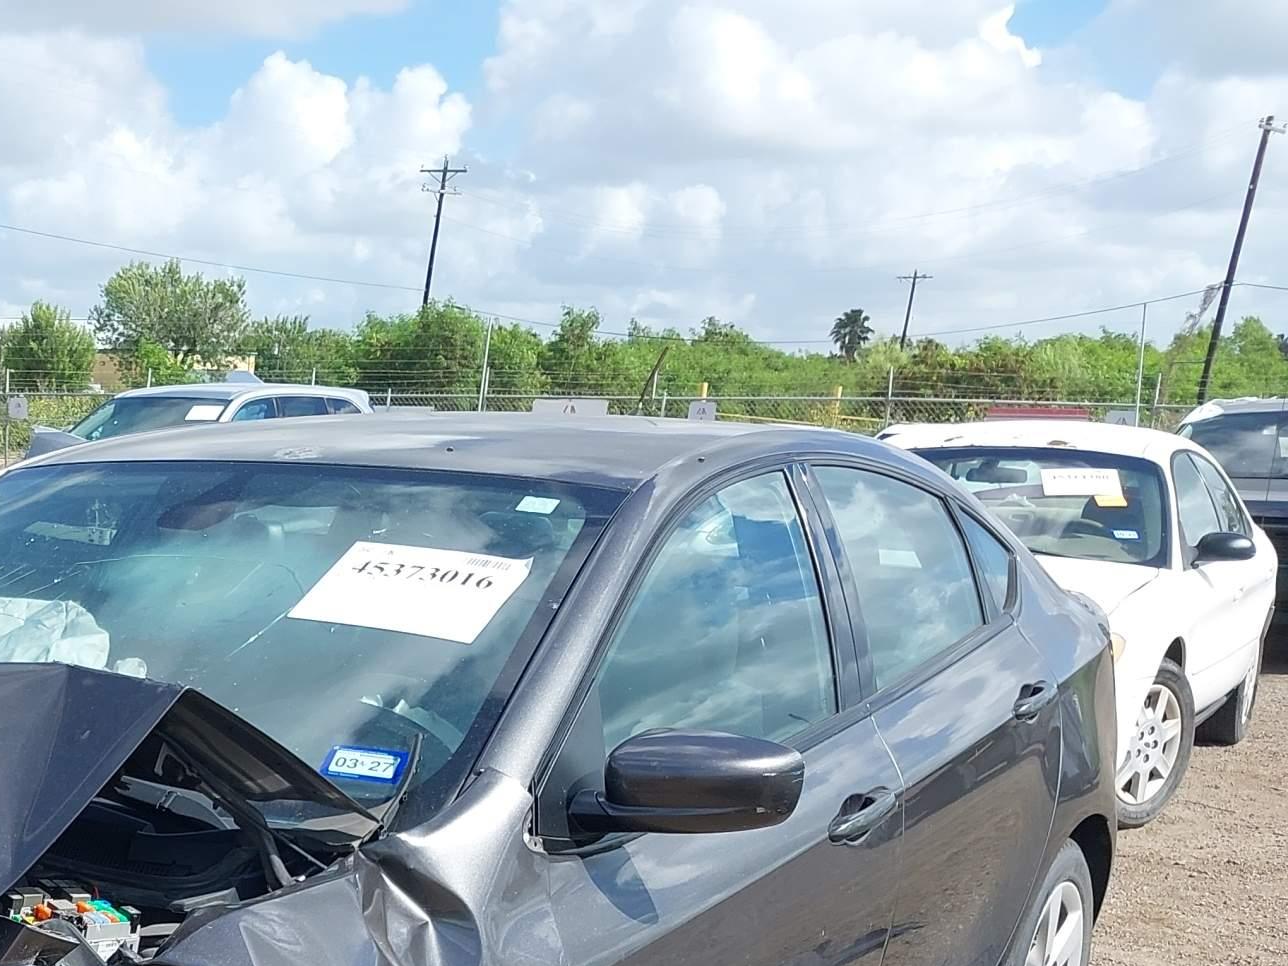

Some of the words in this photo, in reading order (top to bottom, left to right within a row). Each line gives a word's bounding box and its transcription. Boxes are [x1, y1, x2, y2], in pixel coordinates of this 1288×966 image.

[351, 560, 494, 590] 45373016
[335, 756, 359, 769] 03
[368, 760, 394, 773] 27
